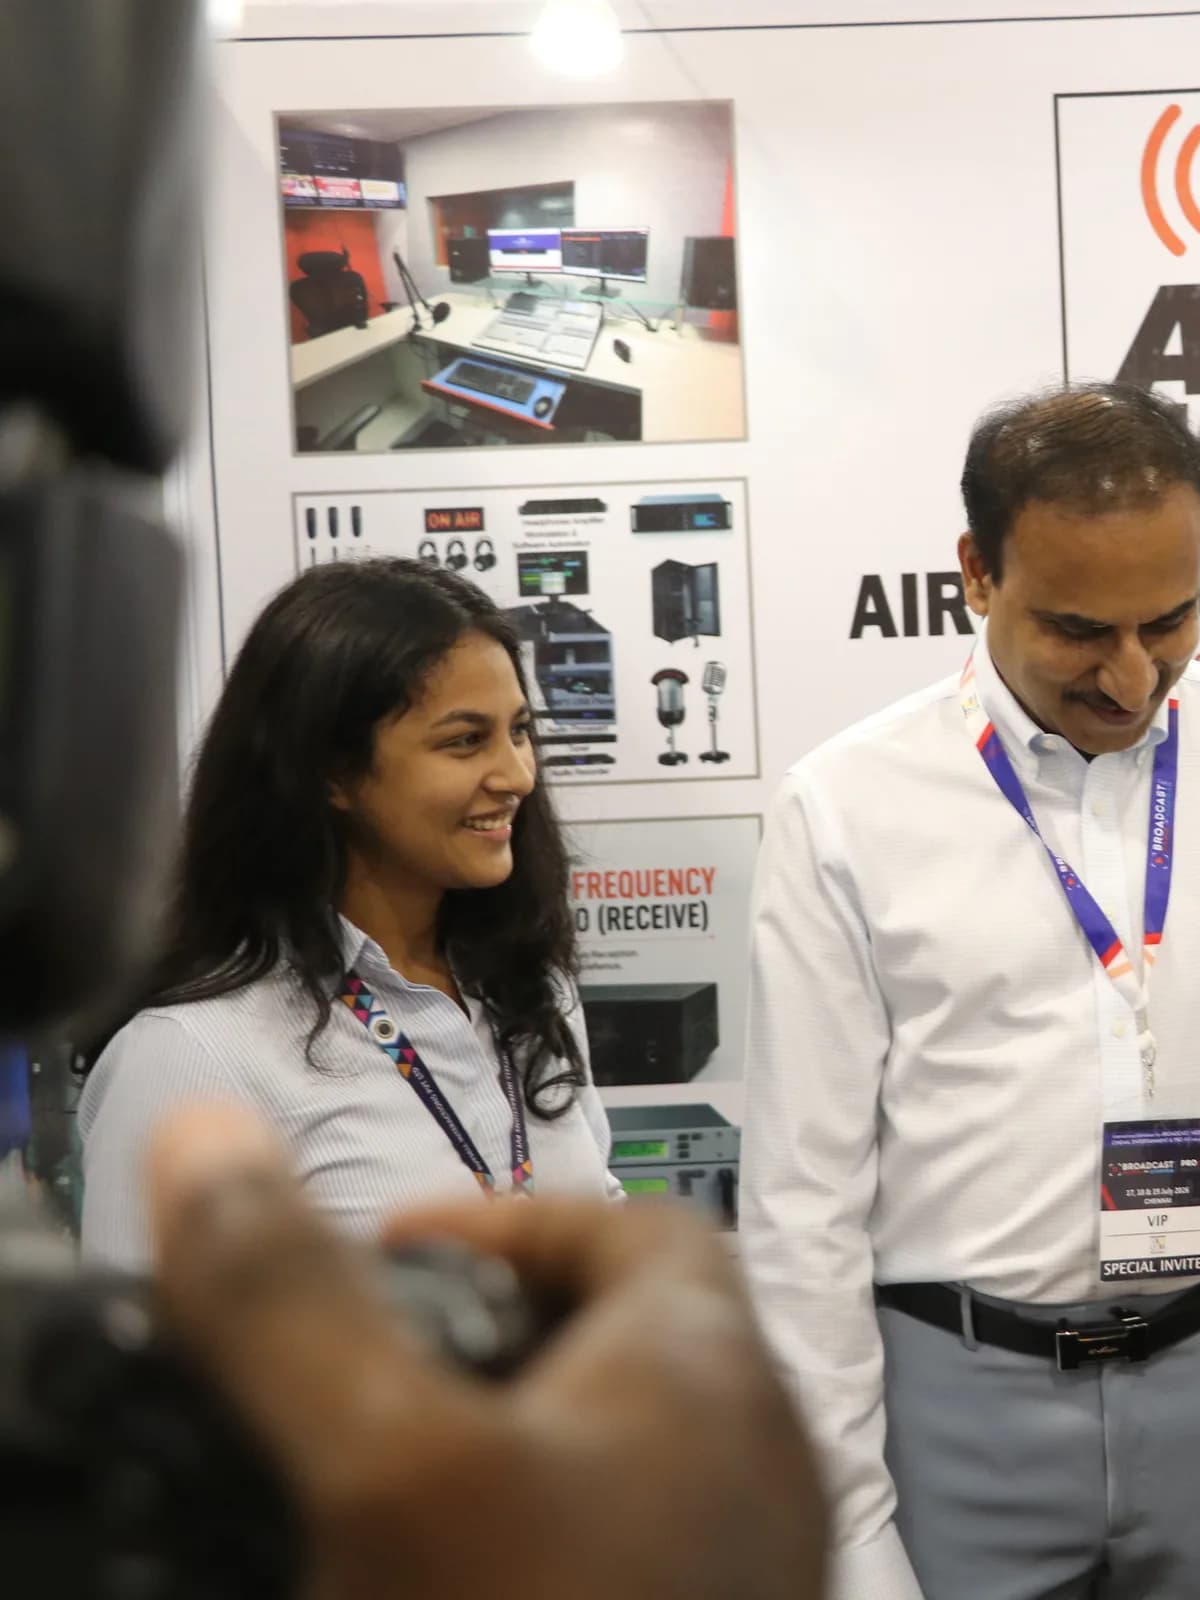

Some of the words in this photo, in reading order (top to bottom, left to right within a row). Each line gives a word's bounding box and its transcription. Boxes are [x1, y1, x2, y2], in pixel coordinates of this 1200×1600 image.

[428, 511, 450, 529] ON
[455, 511, 481, 528] AIR
[572, 866, 716, 900] FREQUENCY
[598, 900, 709, 936] (RECEIVE)
[1122, 1160, 1175, 1171] BROADCAST
[1147, 1214, 1169, 1227] VIP
[1103, 1261, 1156, 1276] SPECIAL
